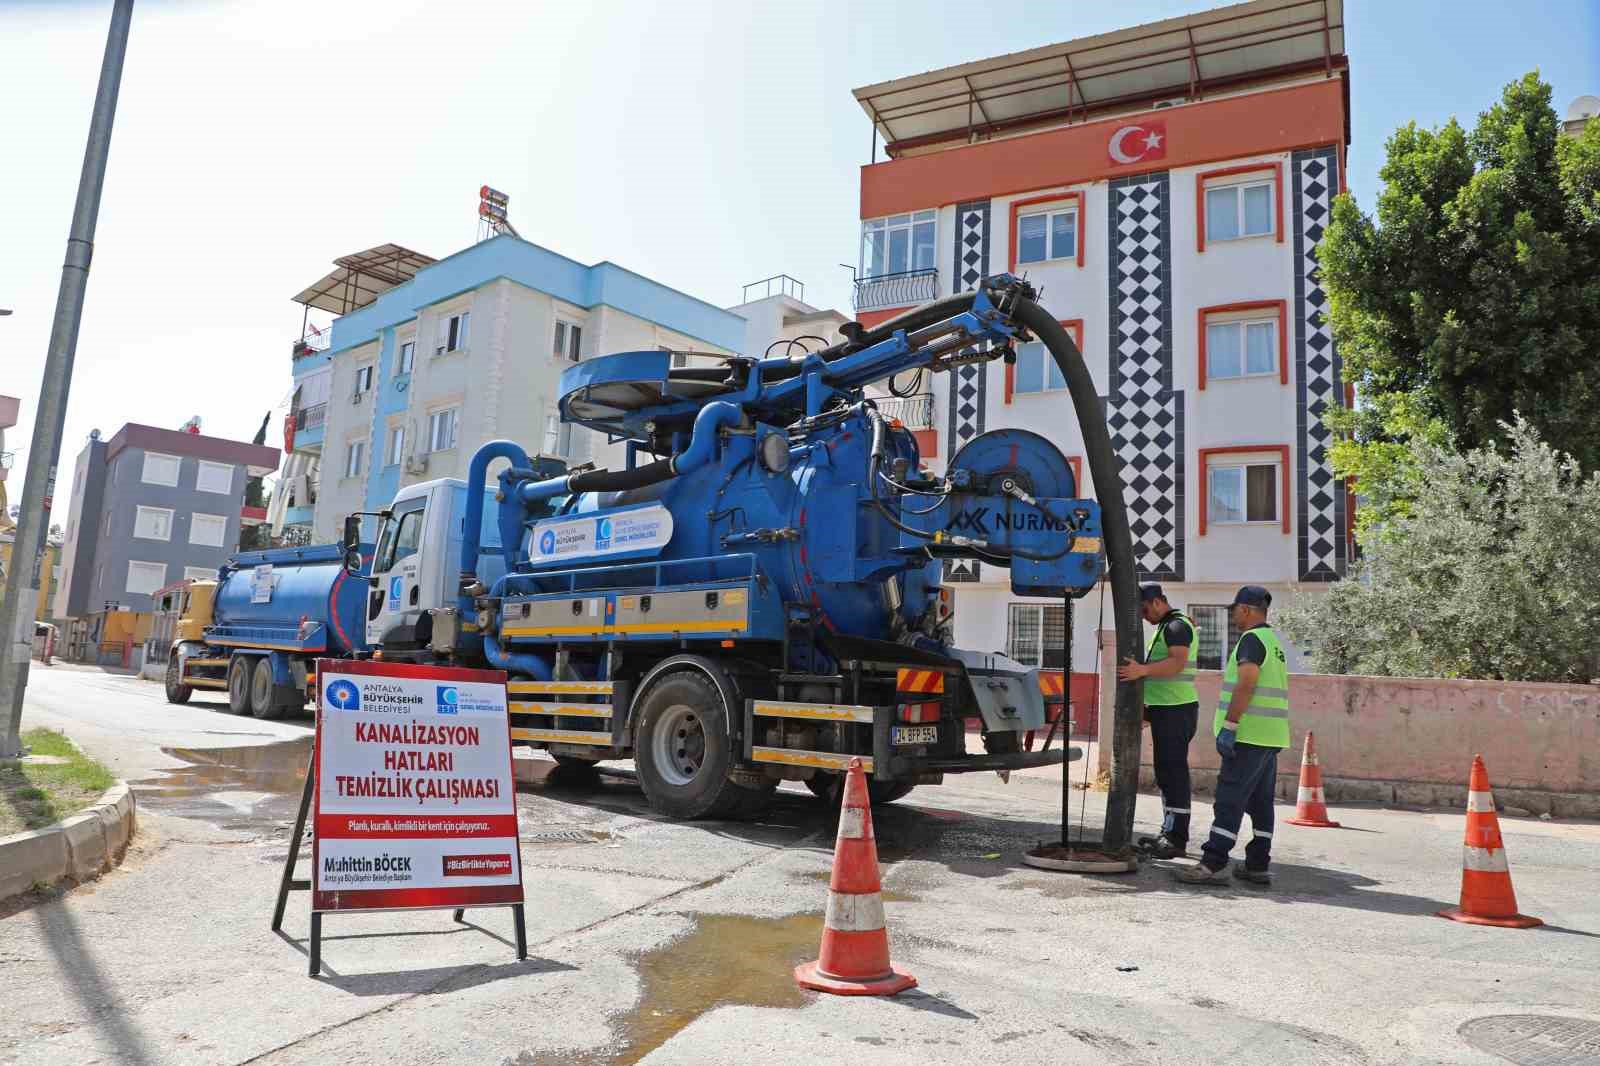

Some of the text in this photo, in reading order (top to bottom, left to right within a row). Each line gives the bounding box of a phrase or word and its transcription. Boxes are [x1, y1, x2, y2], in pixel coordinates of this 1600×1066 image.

[364, 684, 403, 693] ANTALYA
[364, 693, 424, 705] BÜYÜKŞEHİR
[364, 703, 411, 714] BELEDİYESİ
[356, 720, 480, 746] KANALİZASYON
[385, 750, 453, 771] HATLARI
[336, 771, 499, 804] TEMİZLİK ÇALIŞMASI
[418, 820, 428, 831] bir
[428, 820, 442, 831] kent
[443, 821, 455, 833] için
[325, 852, 412, 872] Muhittin BÖCEK
